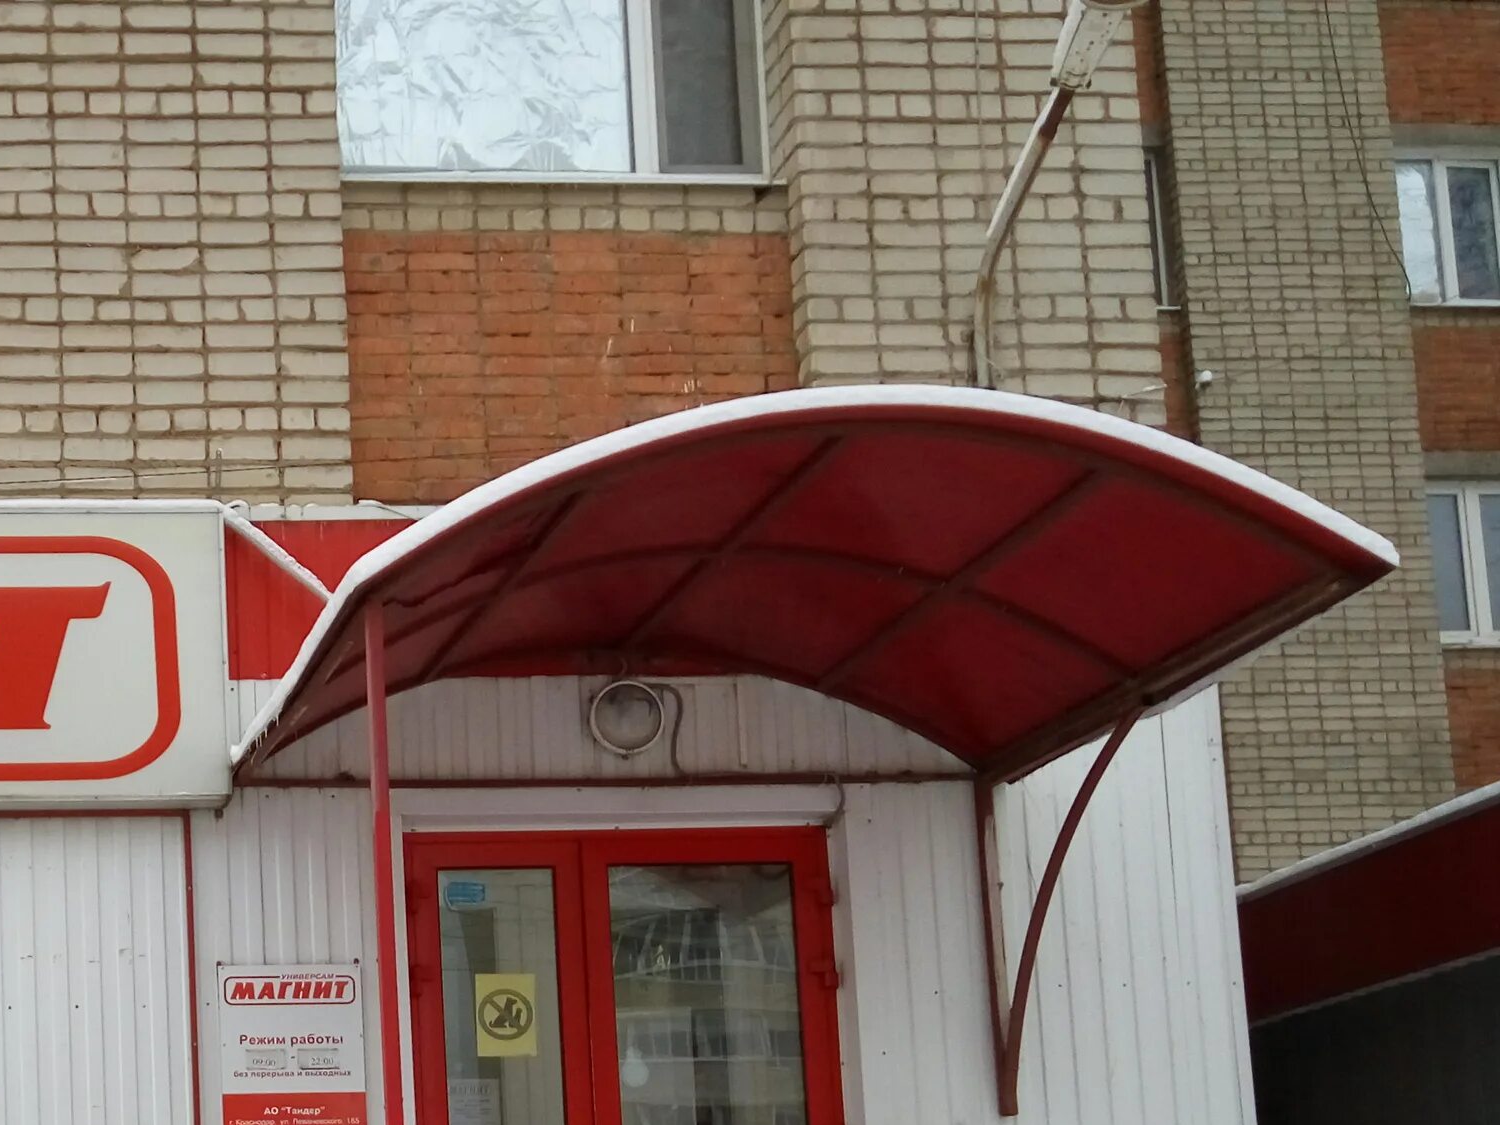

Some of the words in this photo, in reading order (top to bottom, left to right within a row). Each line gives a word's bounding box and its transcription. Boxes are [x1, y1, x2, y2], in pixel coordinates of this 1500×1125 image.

[230, 981, 349, 1000] МАГНИТ
[239, 1034, 286, 1045] Режим
[290, 1033, 344, 1047] работы
[233, 1070, 249, 1078] без
[250, 1071, 295, 1080] перерыва
[305, 1069, 352, 1078] выходных
[263, 1106, 279, 1115] АО
